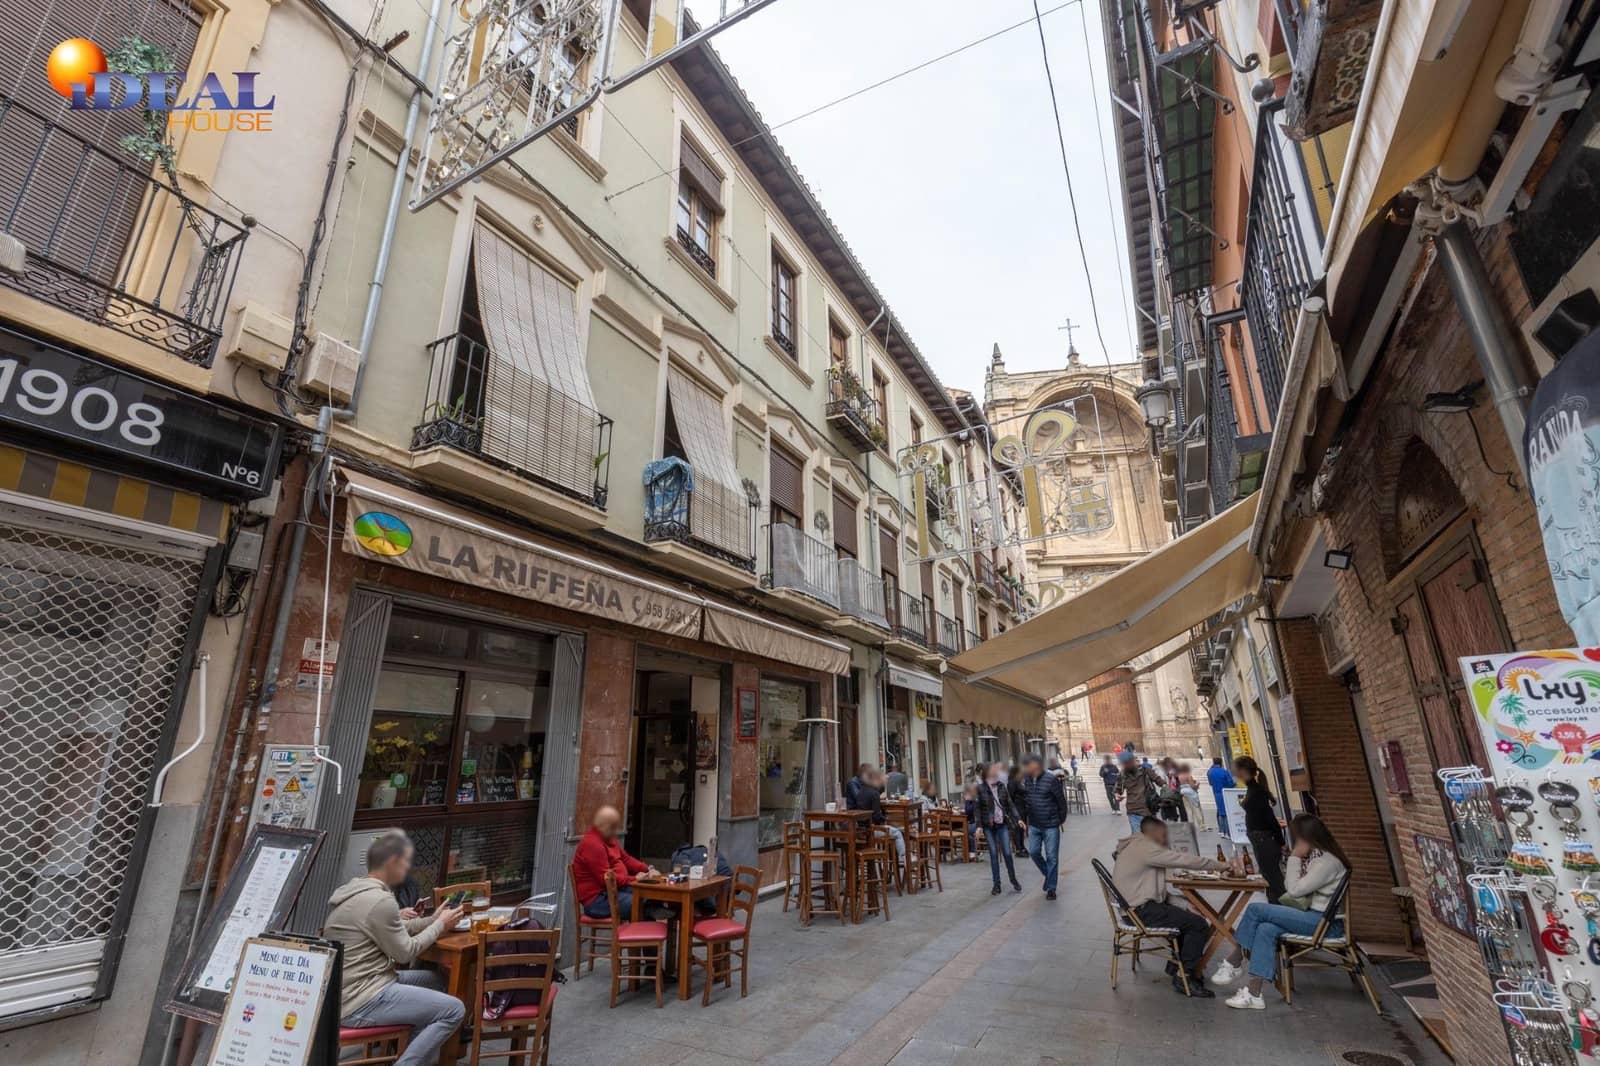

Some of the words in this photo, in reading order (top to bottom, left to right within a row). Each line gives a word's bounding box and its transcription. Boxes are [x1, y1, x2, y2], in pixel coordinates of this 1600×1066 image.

[0, 358, 165, 446] 1908
[428, 535, 480, 574] LA
[492, 554, 623, 613] RIFFEÑA
[646, 600, 663, 618] 958
